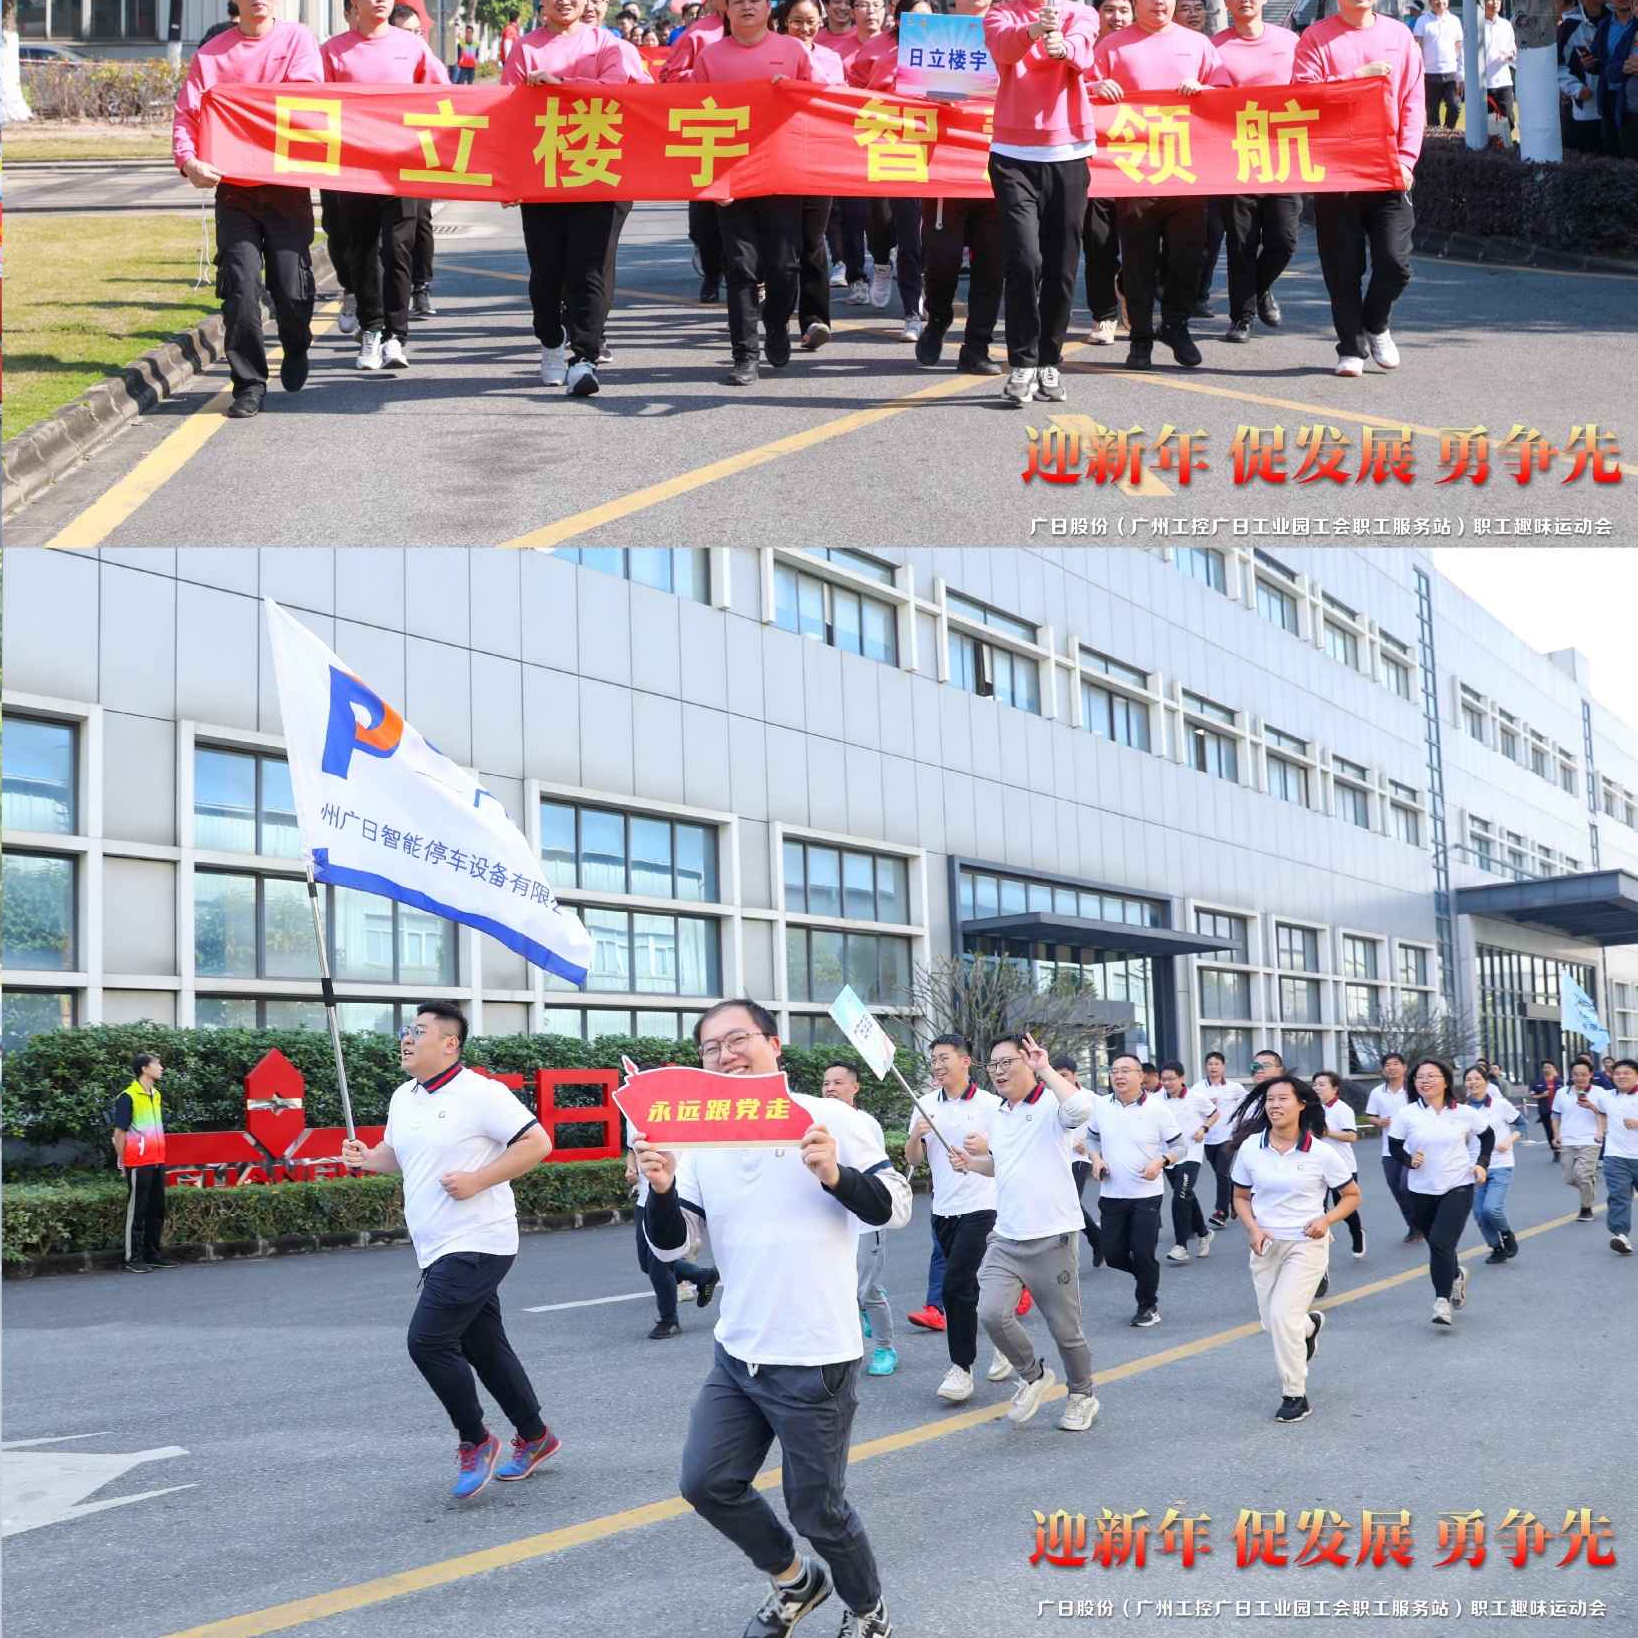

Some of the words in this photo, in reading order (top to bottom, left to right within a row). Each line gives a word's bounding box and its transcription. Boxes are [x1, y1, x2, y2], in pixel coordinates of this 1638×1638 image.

[910, 48, 987, 71] 日立楼宇
[273, 96, 751, 188] 日立楼宇
[853, 98, 1325, 184] 智领航
[647, 1098, 791, 1123] 永远跟党走
